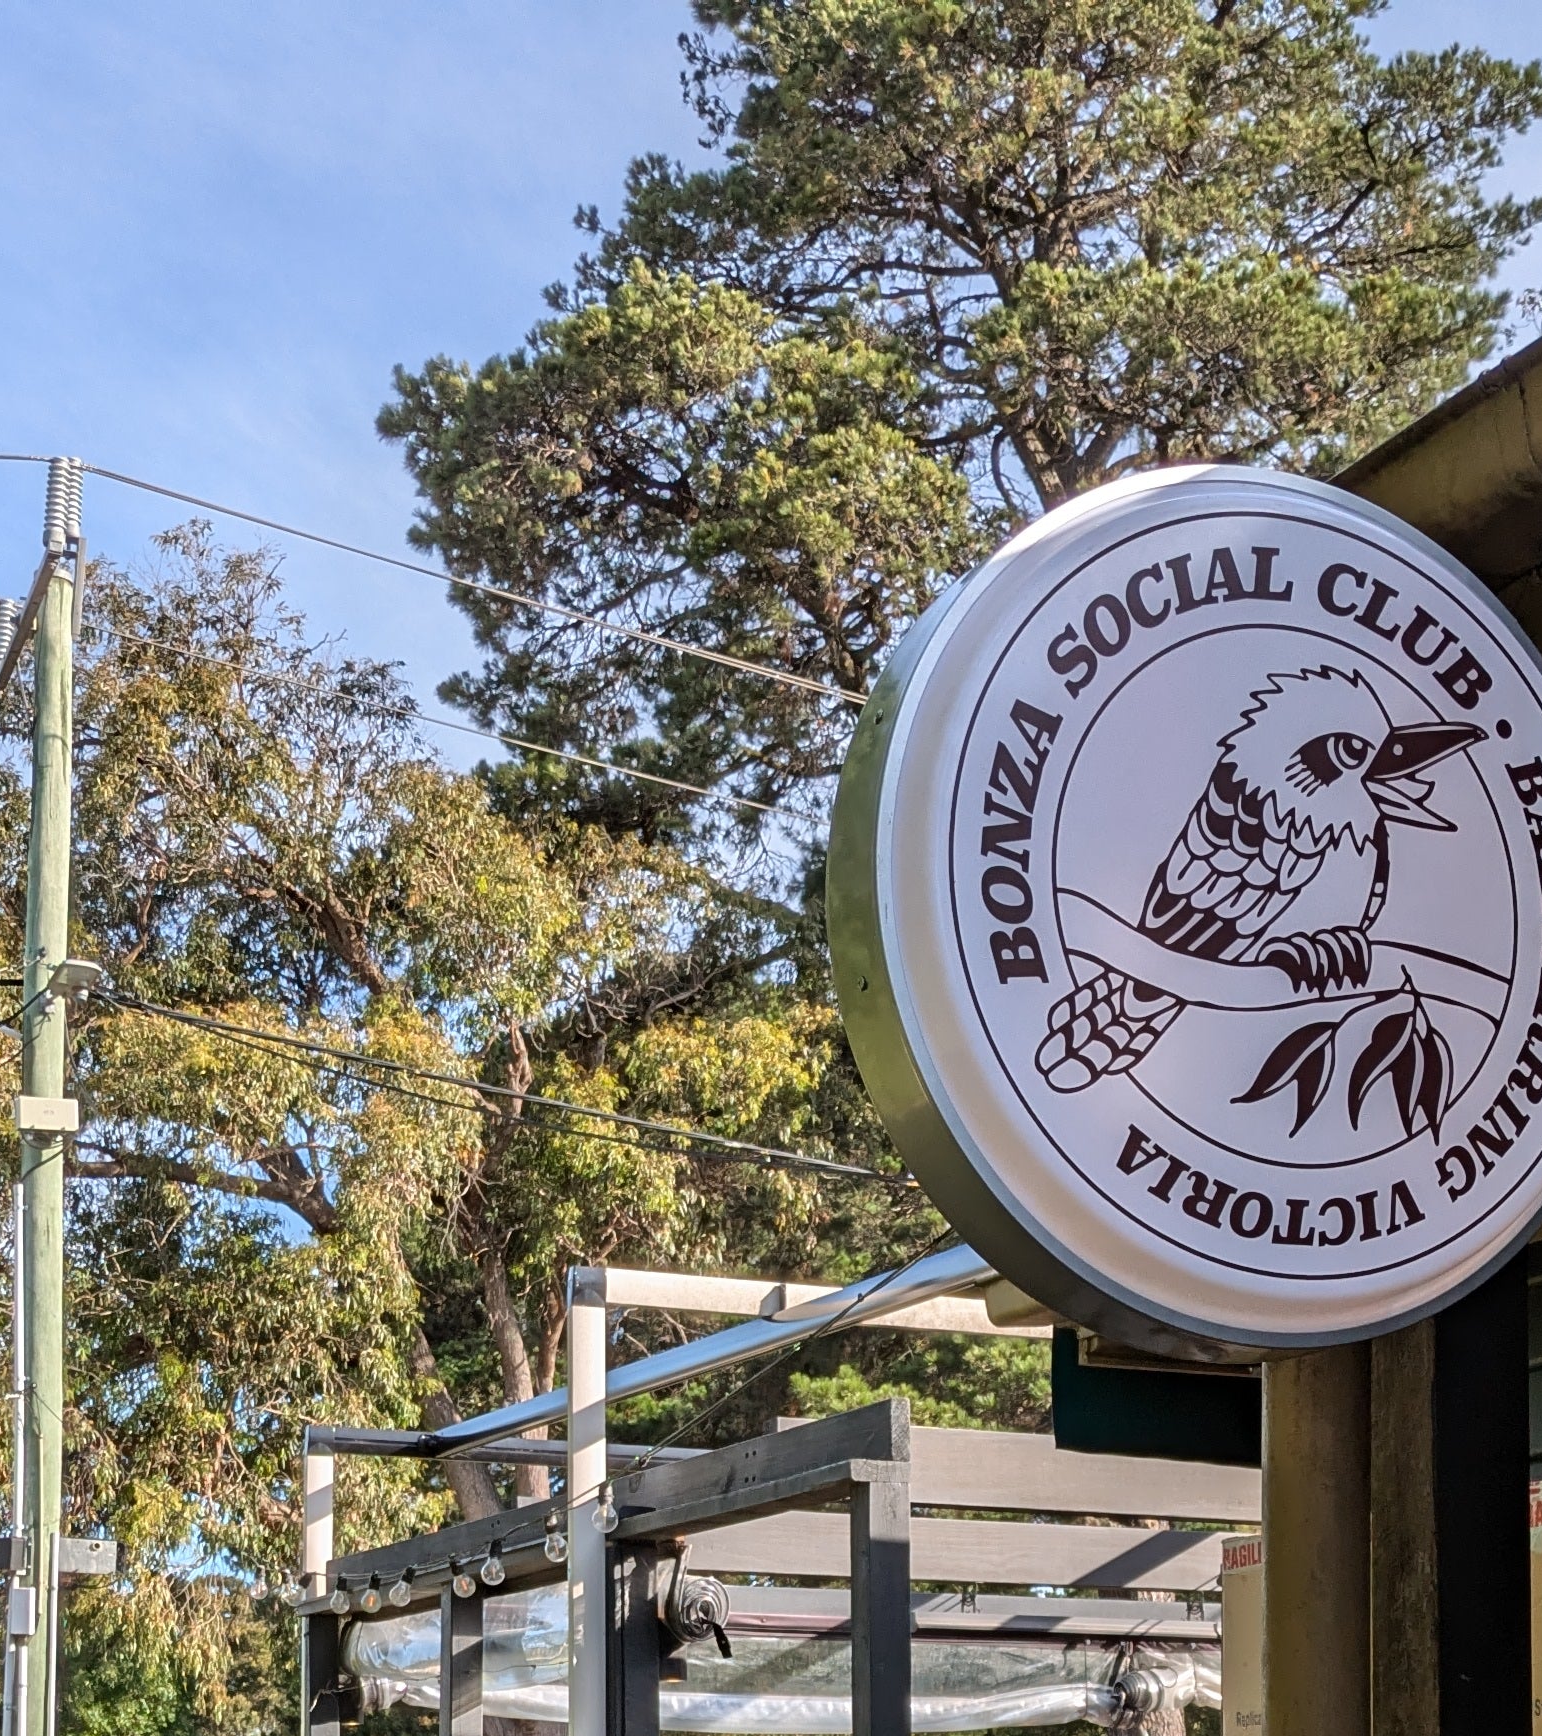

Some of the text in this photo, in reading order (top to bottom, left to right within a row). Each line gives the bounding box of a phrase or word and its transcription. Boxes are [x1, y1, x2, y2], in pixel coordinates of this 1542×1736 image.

[981, 546, 1493, 986] BONZA SOCIAL CLUB
[1116, 1123, 1425, 1246] VICTORIA
